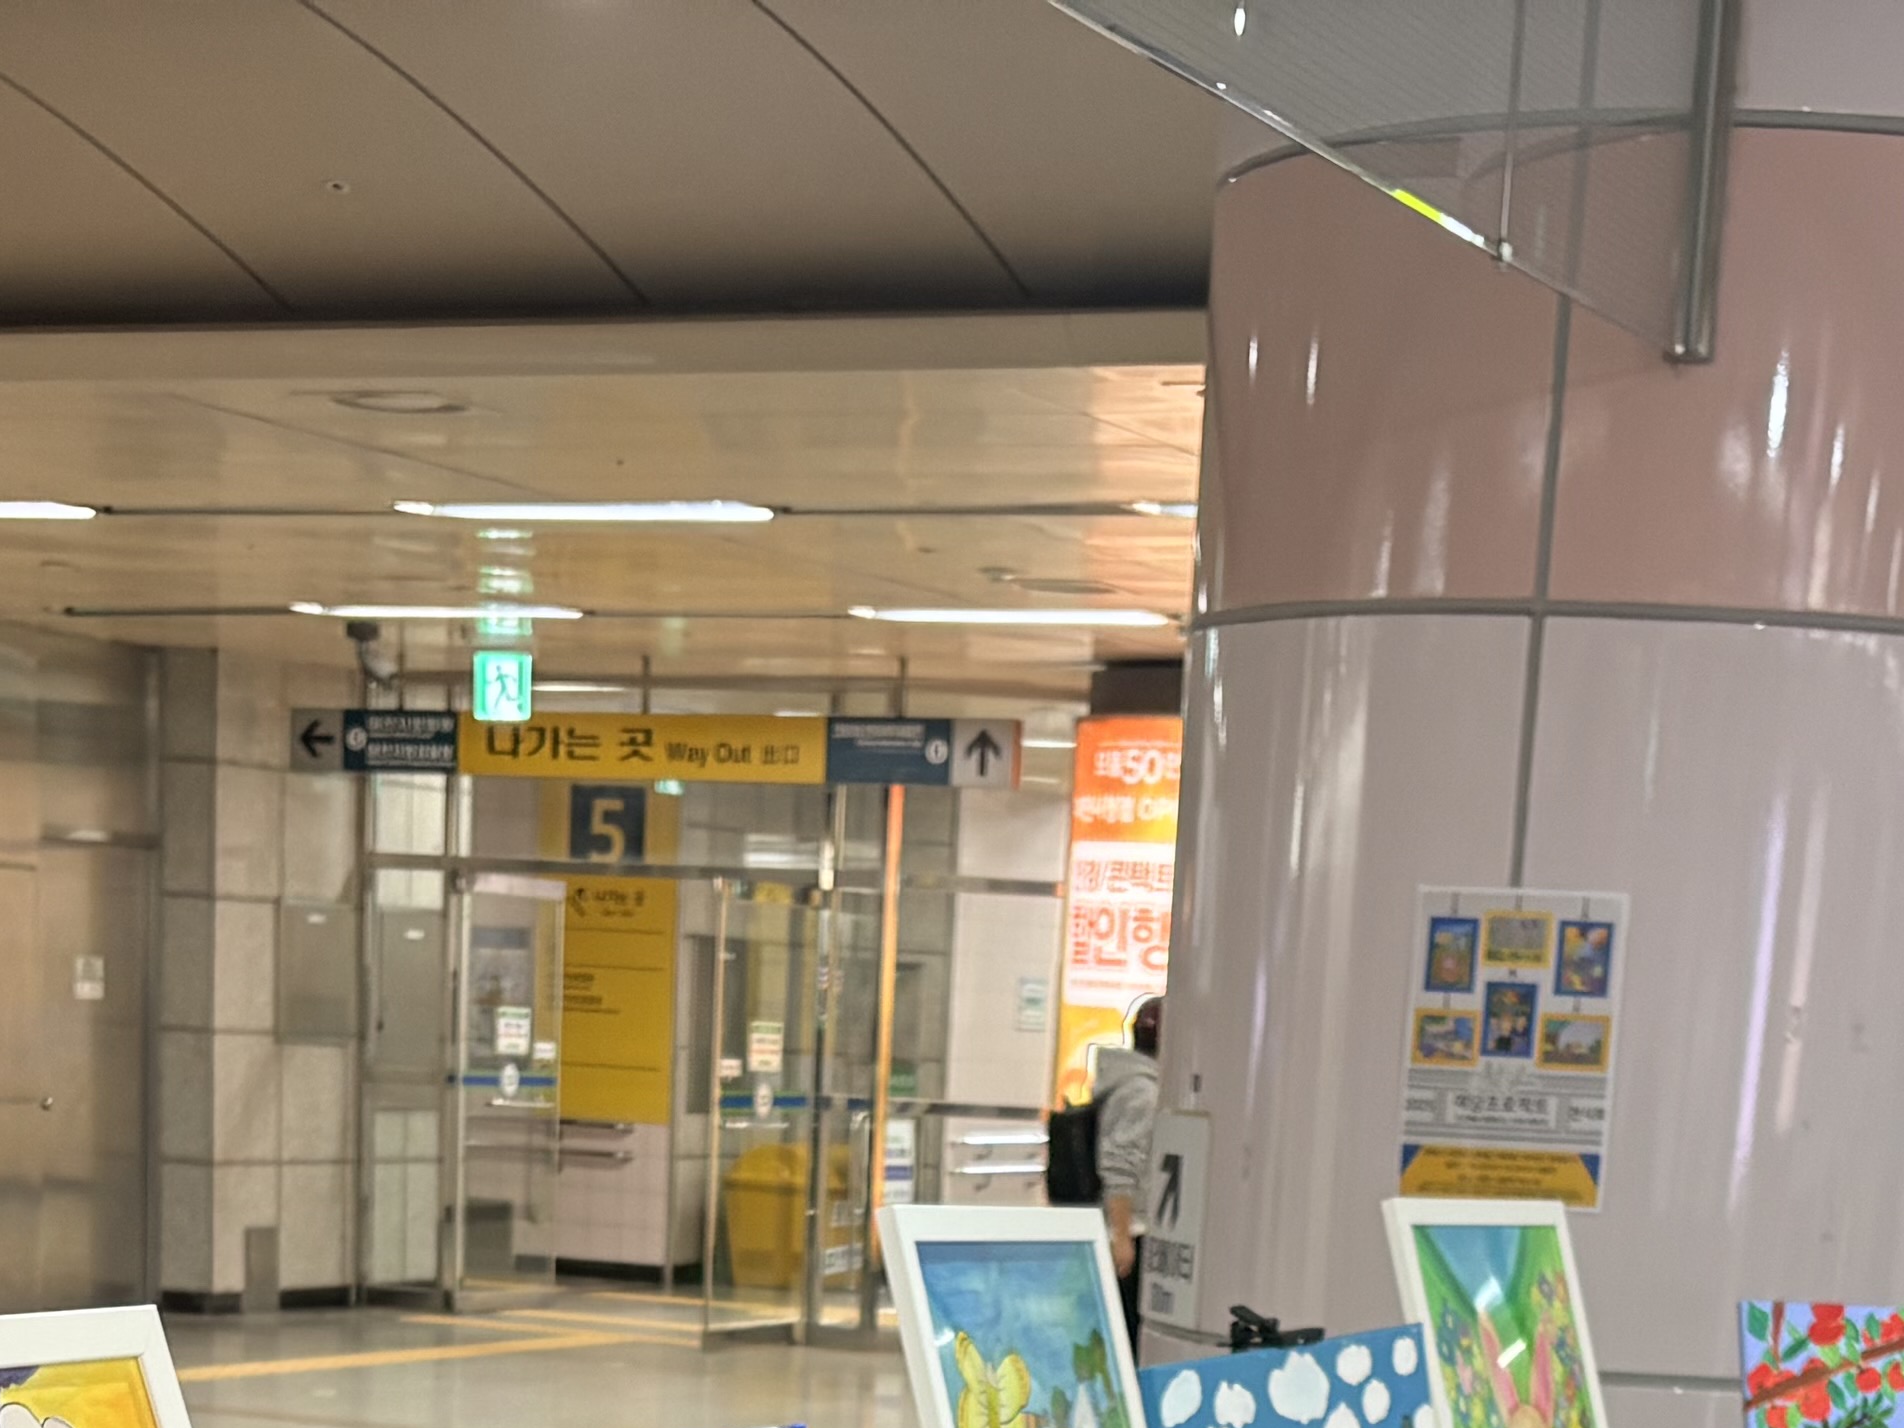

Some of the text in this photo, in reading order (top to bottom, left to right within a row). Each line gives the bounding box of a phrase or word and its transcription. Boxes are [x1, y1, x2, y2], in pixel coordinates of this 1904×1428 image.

[486, 721, 602, 763] 나가는
[618, 727, 655, 764] 곳
[664, 742, 711, 769] Way
[715, 741, 752, 765] Out
[589, 797, 627, 865] 5
